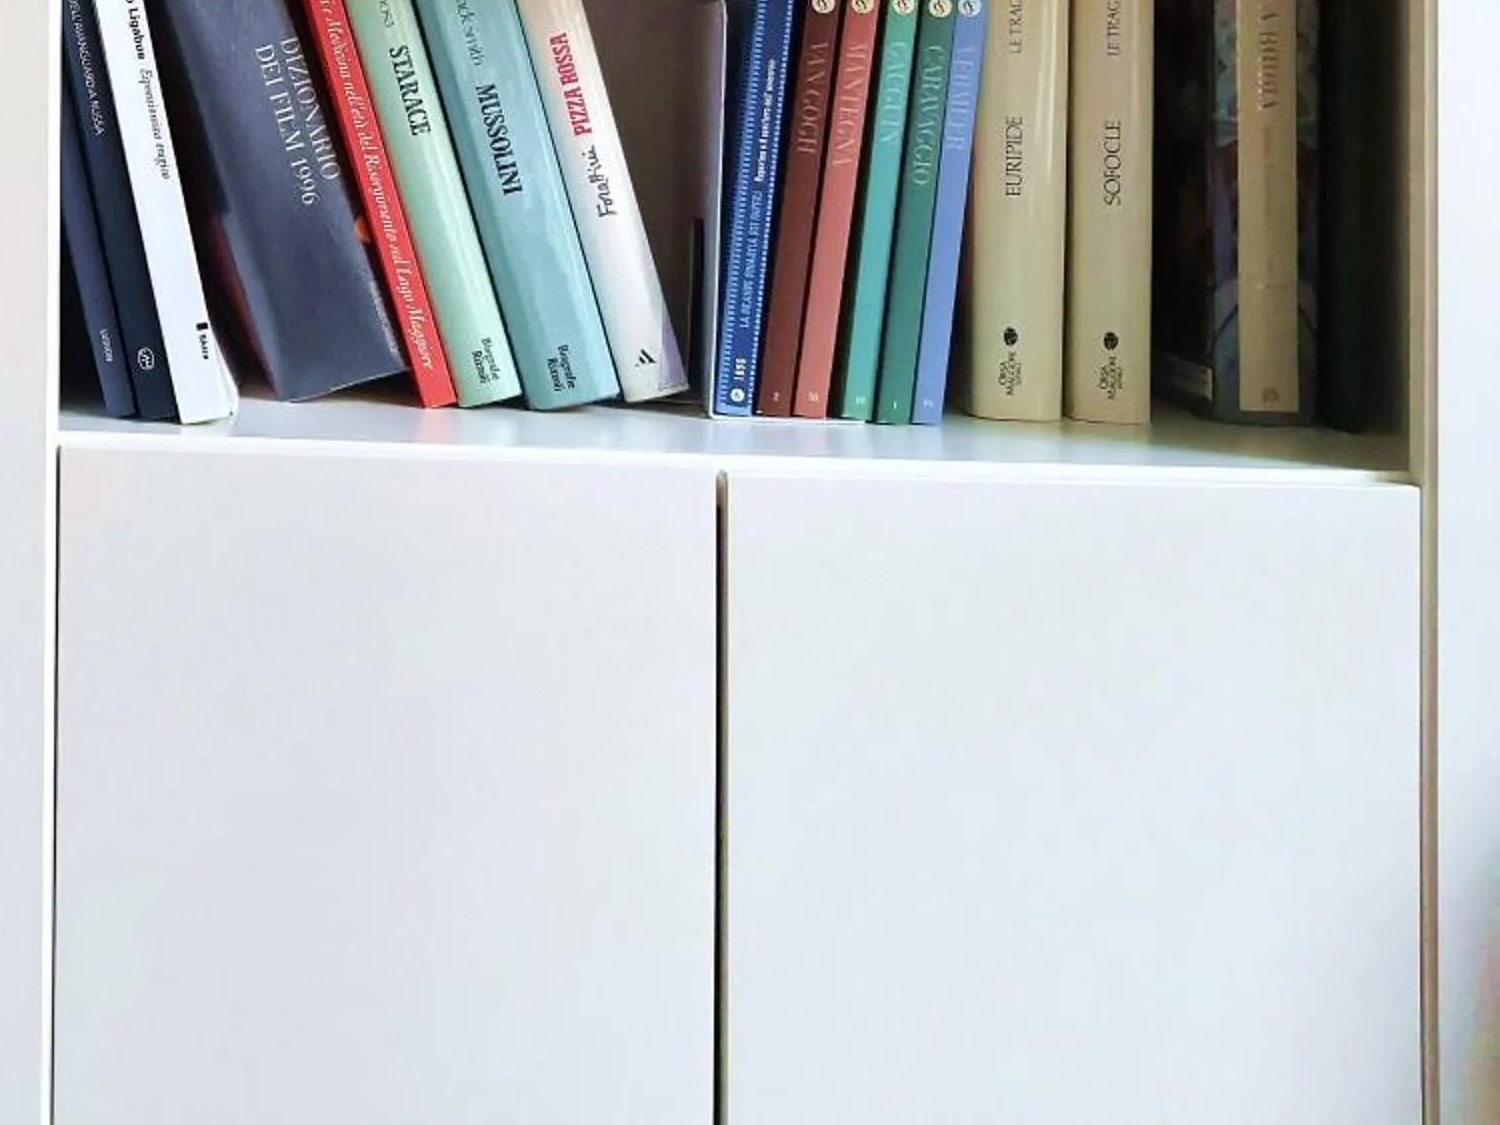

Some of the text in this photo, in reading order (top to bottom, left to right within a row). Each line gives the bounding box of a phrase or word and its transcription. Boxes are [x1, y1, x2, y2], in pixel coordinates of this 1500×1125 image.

[129, 7, 144, 59] Ligabue
[550, 33, 591, 135] PIZZA ROSSA
[1009, 38, 1022, 53] LE
[1107, 42, 1119, 57] LE
[255, 44, 315, 204] DEI FILM 1996
[280, 37, 338, 179] DIZIONARIO
[390, 45, 430, 135] STARACE
[477, 85, 521, 194] MUSSOLINI
[798, 42, 828, 153] VAN GOGH
[833, 44, 866, 165] MANTEGNA
[880, 40, 908, 145] GAUGUIN
[914, 45, 943, 185] CARAVAGGIO
[945, 45, 973, 151] VERMEER
[1005, 118, 1022, 195] EURIPIDE
[1103, 122, 1121, 205] SOFOCLE
[357, 132, 376, 150] del
[396, 267, 413, 302] Lago
